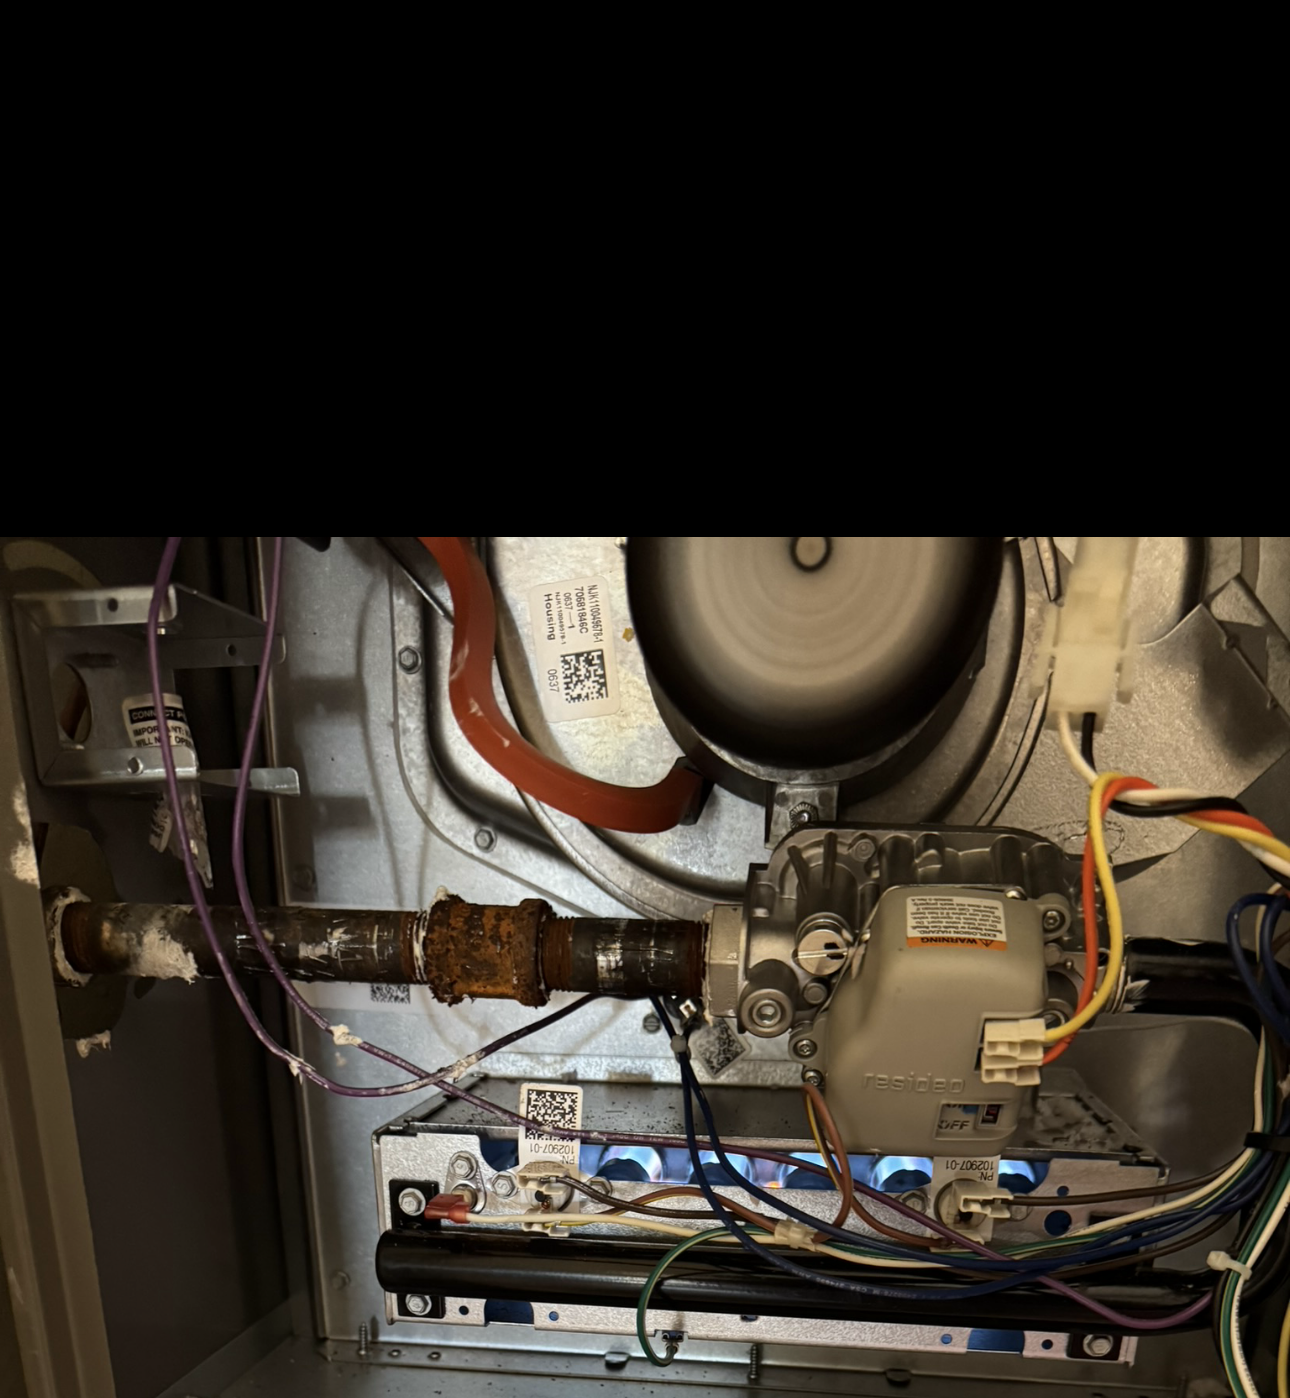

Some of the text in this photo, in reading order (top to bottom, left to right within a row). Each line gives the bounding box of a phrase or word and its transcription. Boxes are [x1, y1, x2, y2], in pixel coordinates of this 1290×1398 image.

[564, 593, 574, 610] 0637
[544, 593, 556, 641] Housing
[547, 669, 560, 692] 0637
[921, 937, 977, 945] WARNING
[953, 930, 997, 938] EXPLOSION
[862, 1072, 965, 1093] resideo
[530, 1143, 575, 1155] 102907-01
[946, 1160, 994, 1171] 102907-01
